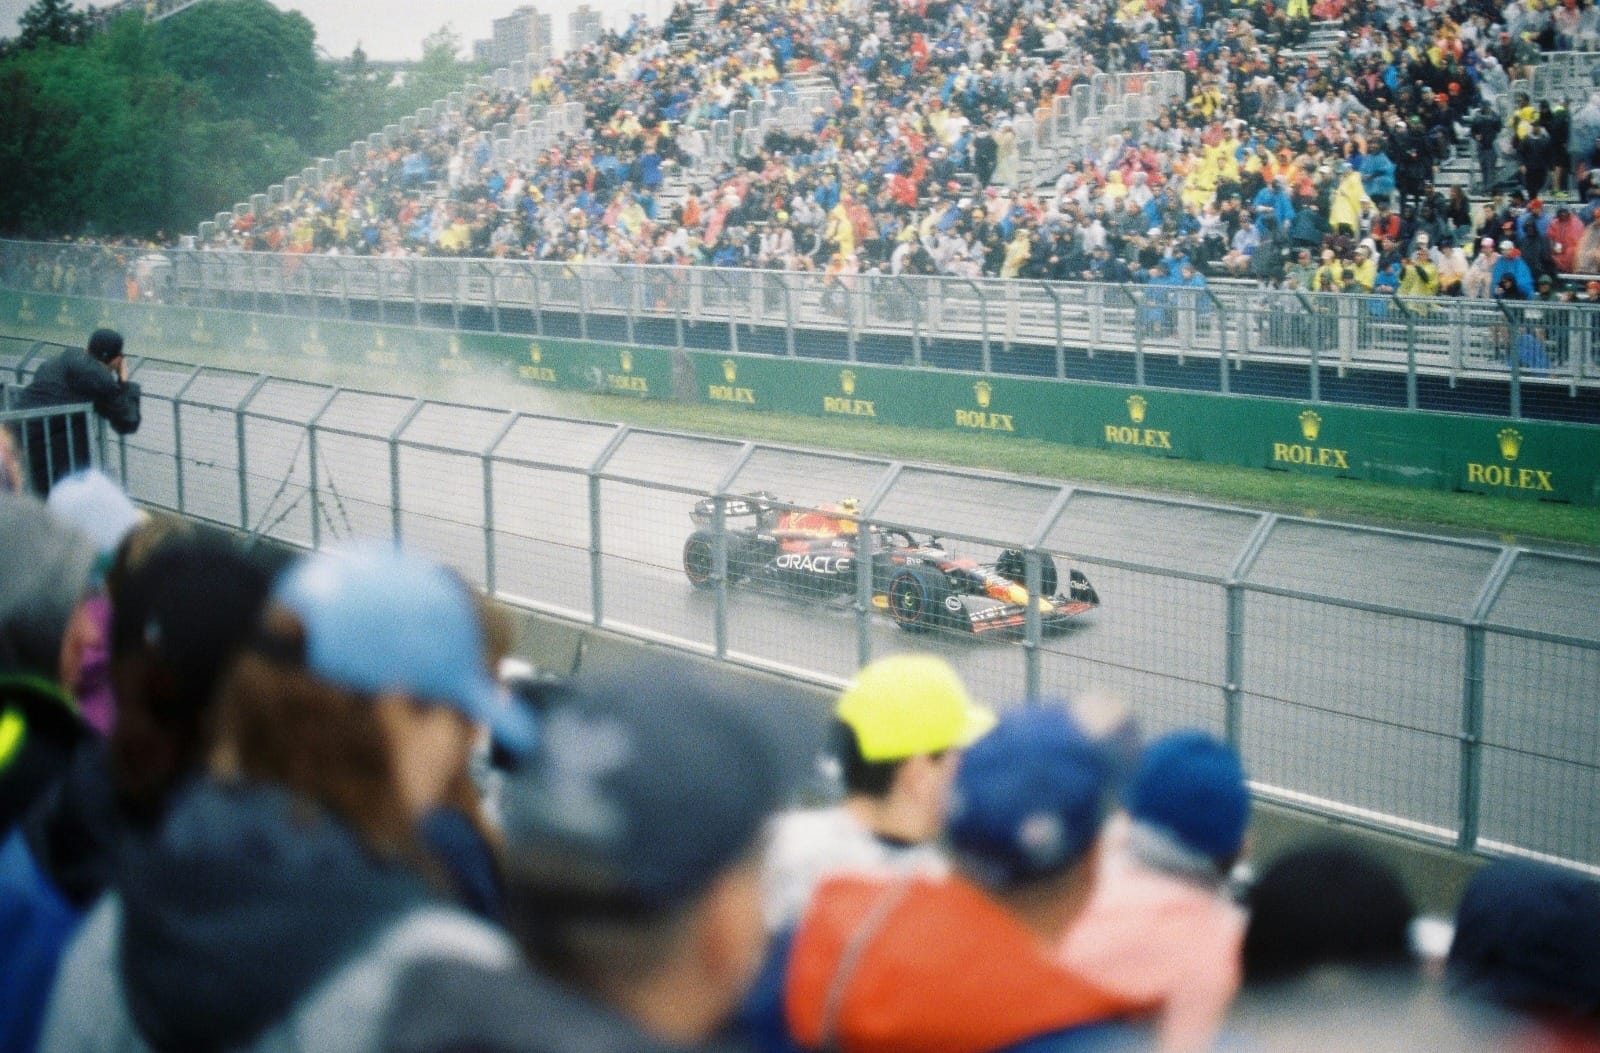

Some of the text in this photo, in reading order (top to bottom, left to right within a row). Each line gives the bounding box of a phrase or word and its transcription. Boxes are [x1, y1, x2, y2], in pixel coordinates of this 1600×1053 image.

[823, 397, 876, 417] ROLEX
[955, 409, 1014, 431] ROLEX
[1105, 425, 1172, 449] ROLEX
[1273, 442, 1349, 469] ROLEX
[1467, 463, 1553, 492] ROLEX
[776, 554, 850, 575] ORACLE
